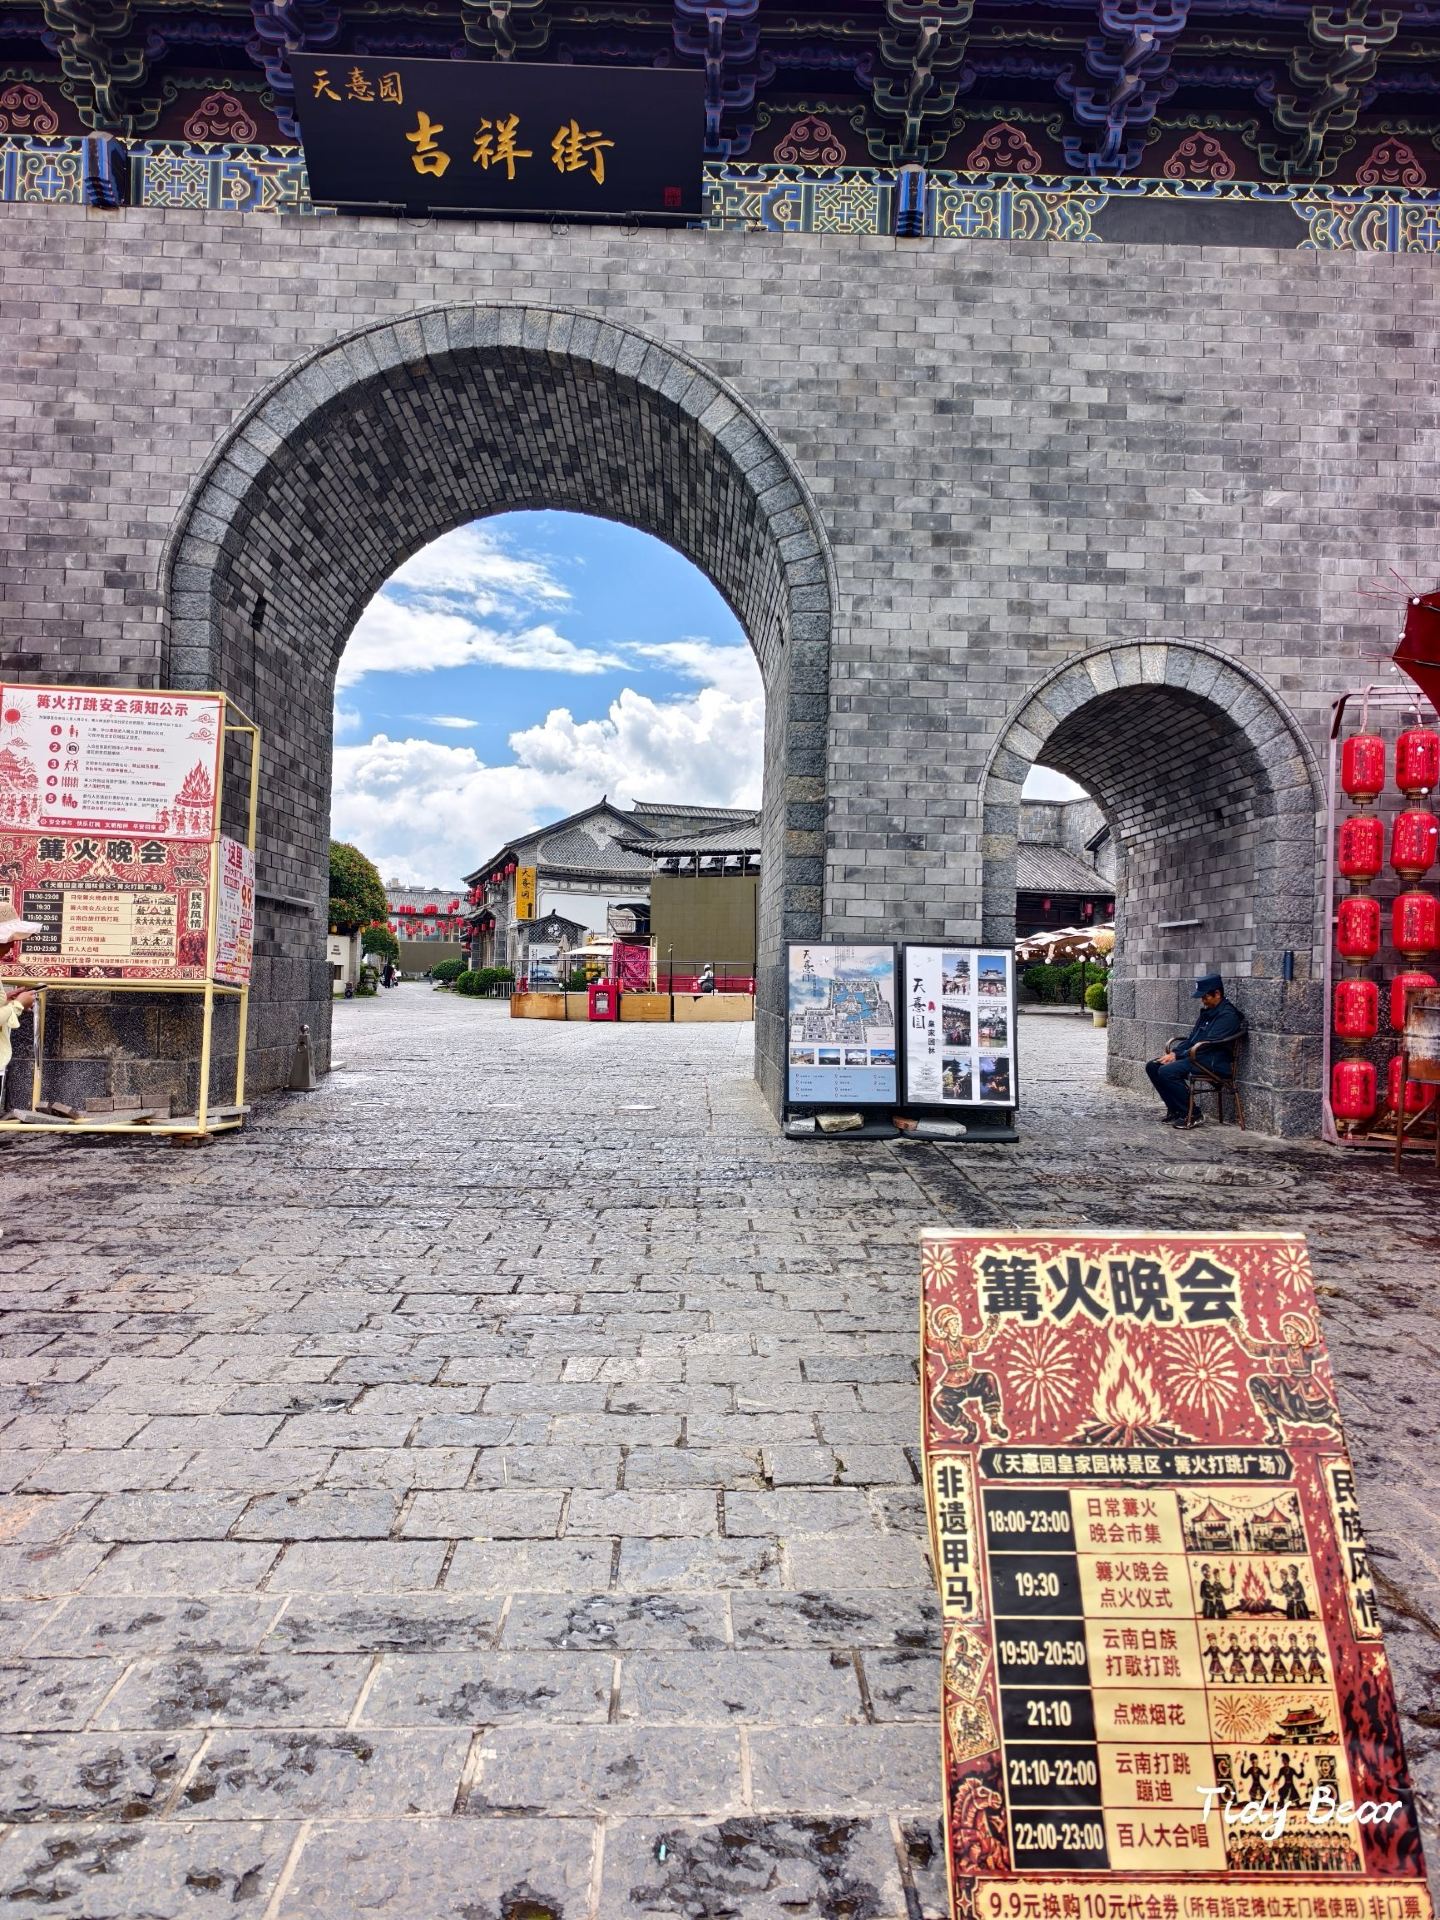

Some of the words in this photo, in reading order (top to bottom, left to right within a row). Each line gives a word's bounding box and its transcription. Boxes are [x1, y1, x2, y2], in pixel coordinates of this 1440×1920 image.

[405, 111, 615, 186] 吉祥街
[37, 694, 189, 717] 篝火打跳安全须知公示
[37, 838, 168, 864] 篝火晚会
[190, 891, 202, 929] 民族风情
[979, 1255, 1237, 1322] 篝火晚会
[1087, 1497, 1158, 1518] 日常篝火
[988, 1510, 1071, 1533] 18:00-23:00
[1090, 1523, 1162, 1544] 晚会市集
[937, 1465, 973, 1614] 非遗甲马
[1096, 1561, 1169, 1582] 篝火晚会
[1015, 1572, 1060, 1597] 19:30
[1100, 1587, 1173, 1609] 点火仪式
[1103, 1628, 1178, 1650] 云南白族
[1000, 1640, 1086, 1666] 19:50-20:50
[1106, 1655, 1181, 1677] 打歌打跳
[1027, 1700, 1072, 1727] 21:10
[1113, 1704, 1186, 1726] 点燃烟花
[1010, 1759, 1097, 1786] 21:10-22:00
[1116, 1752, 1191, 1776] 云南打跳
[1136, 1779, 1173, 1802] 蹦迪
[1015, 1822, 1104, 1850] 22:00-23:00
[1116, 1822, 1210, 1849] 百人大合唱
